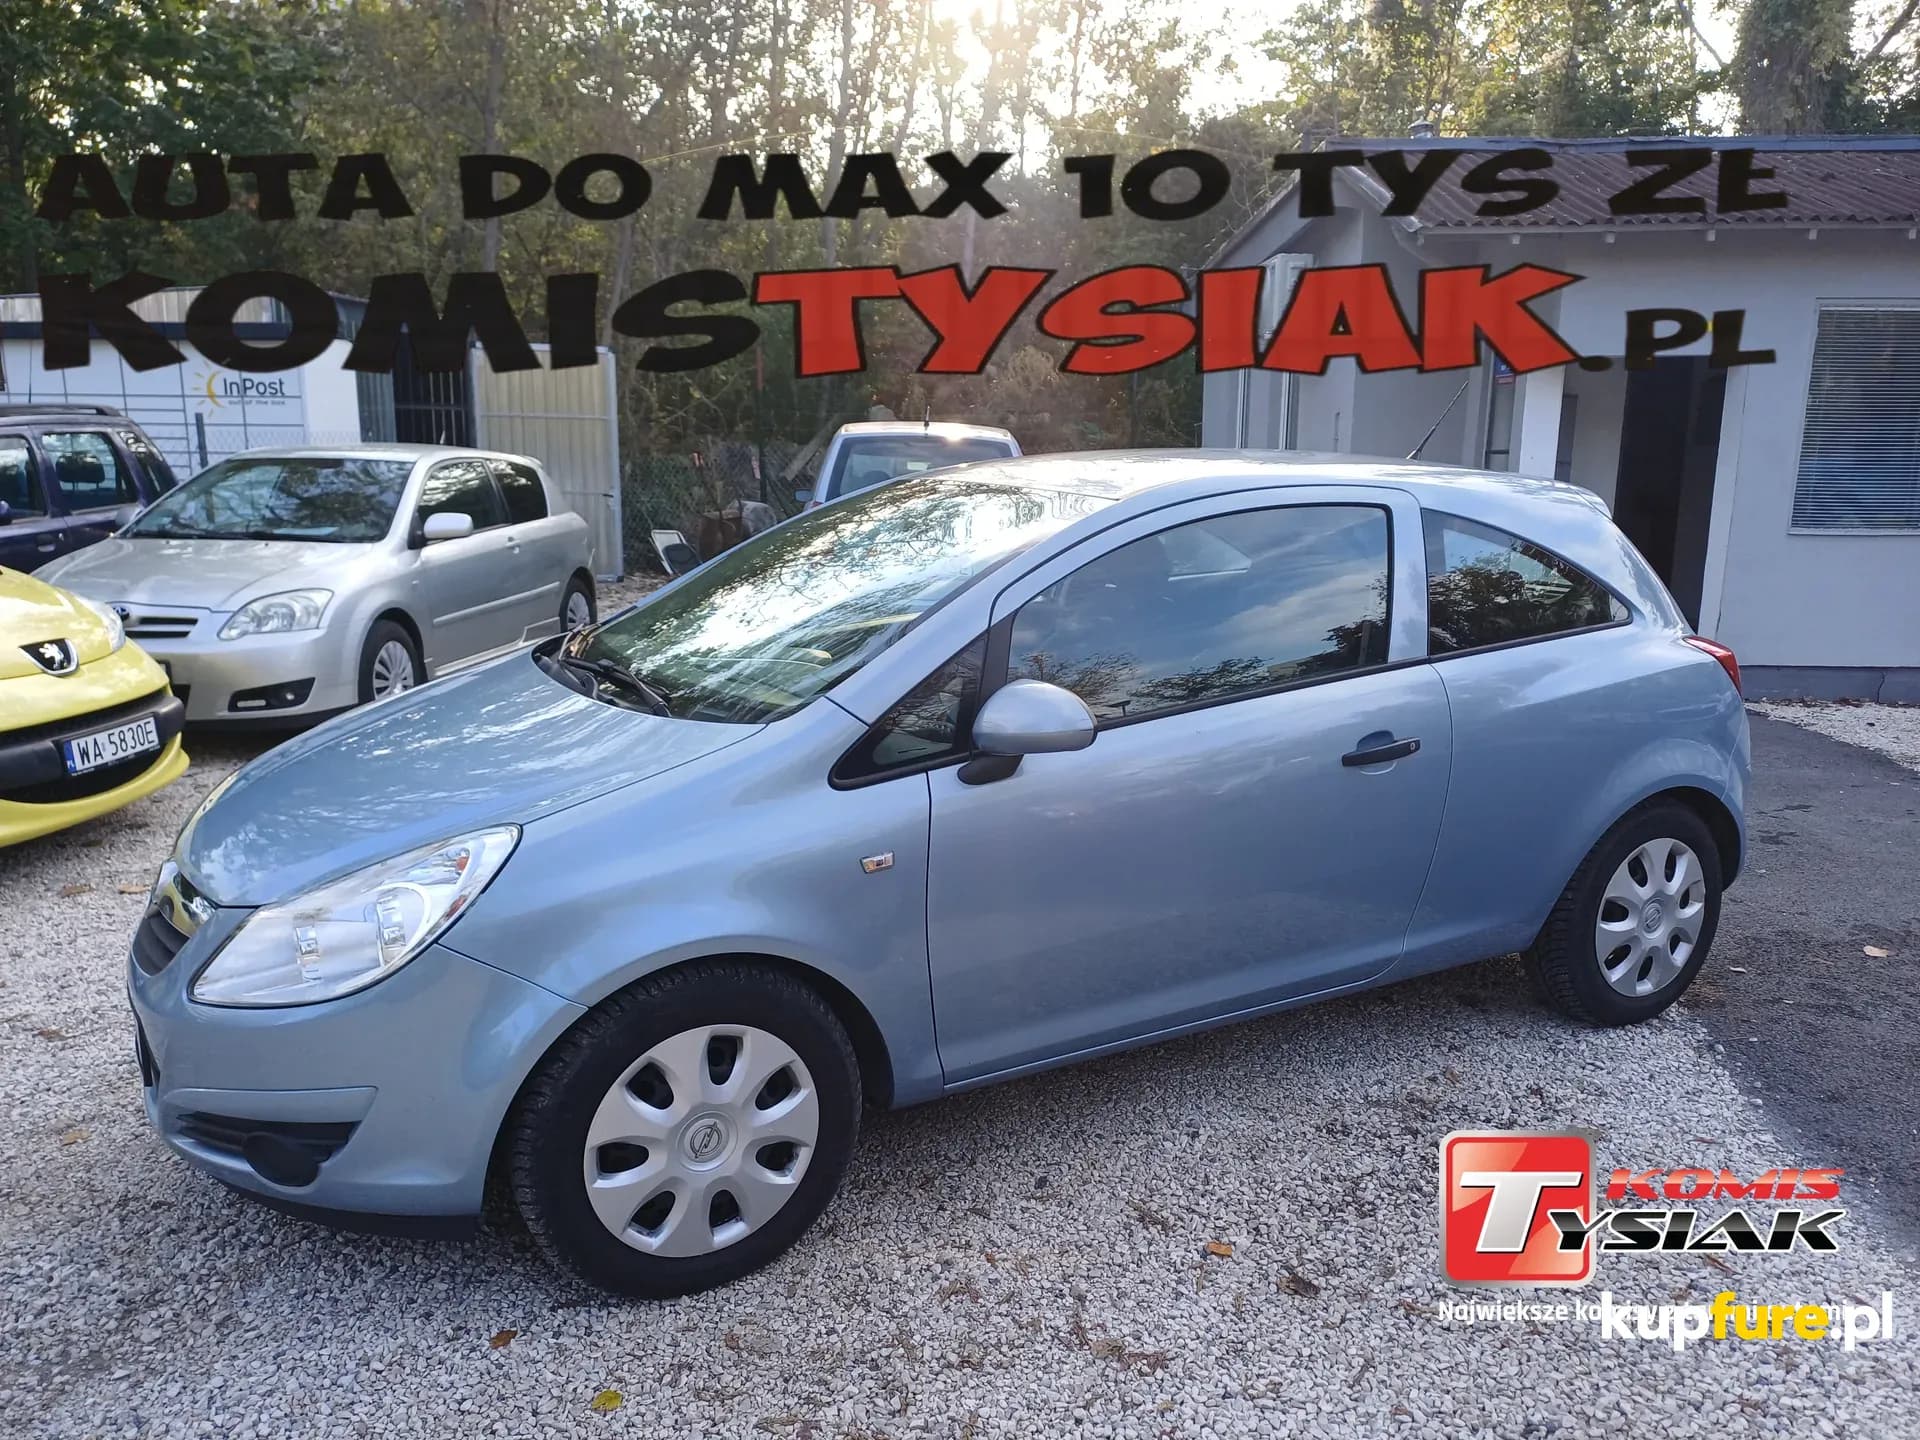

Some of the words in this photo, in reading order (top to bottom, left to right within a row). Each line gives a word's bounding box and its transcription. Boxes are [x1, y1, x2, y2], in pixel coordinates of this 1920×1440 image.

[223, 377, 286, 397] InPost
[77, 737, 104, 767] WA
[107, 721, 154, 756] 5830E
